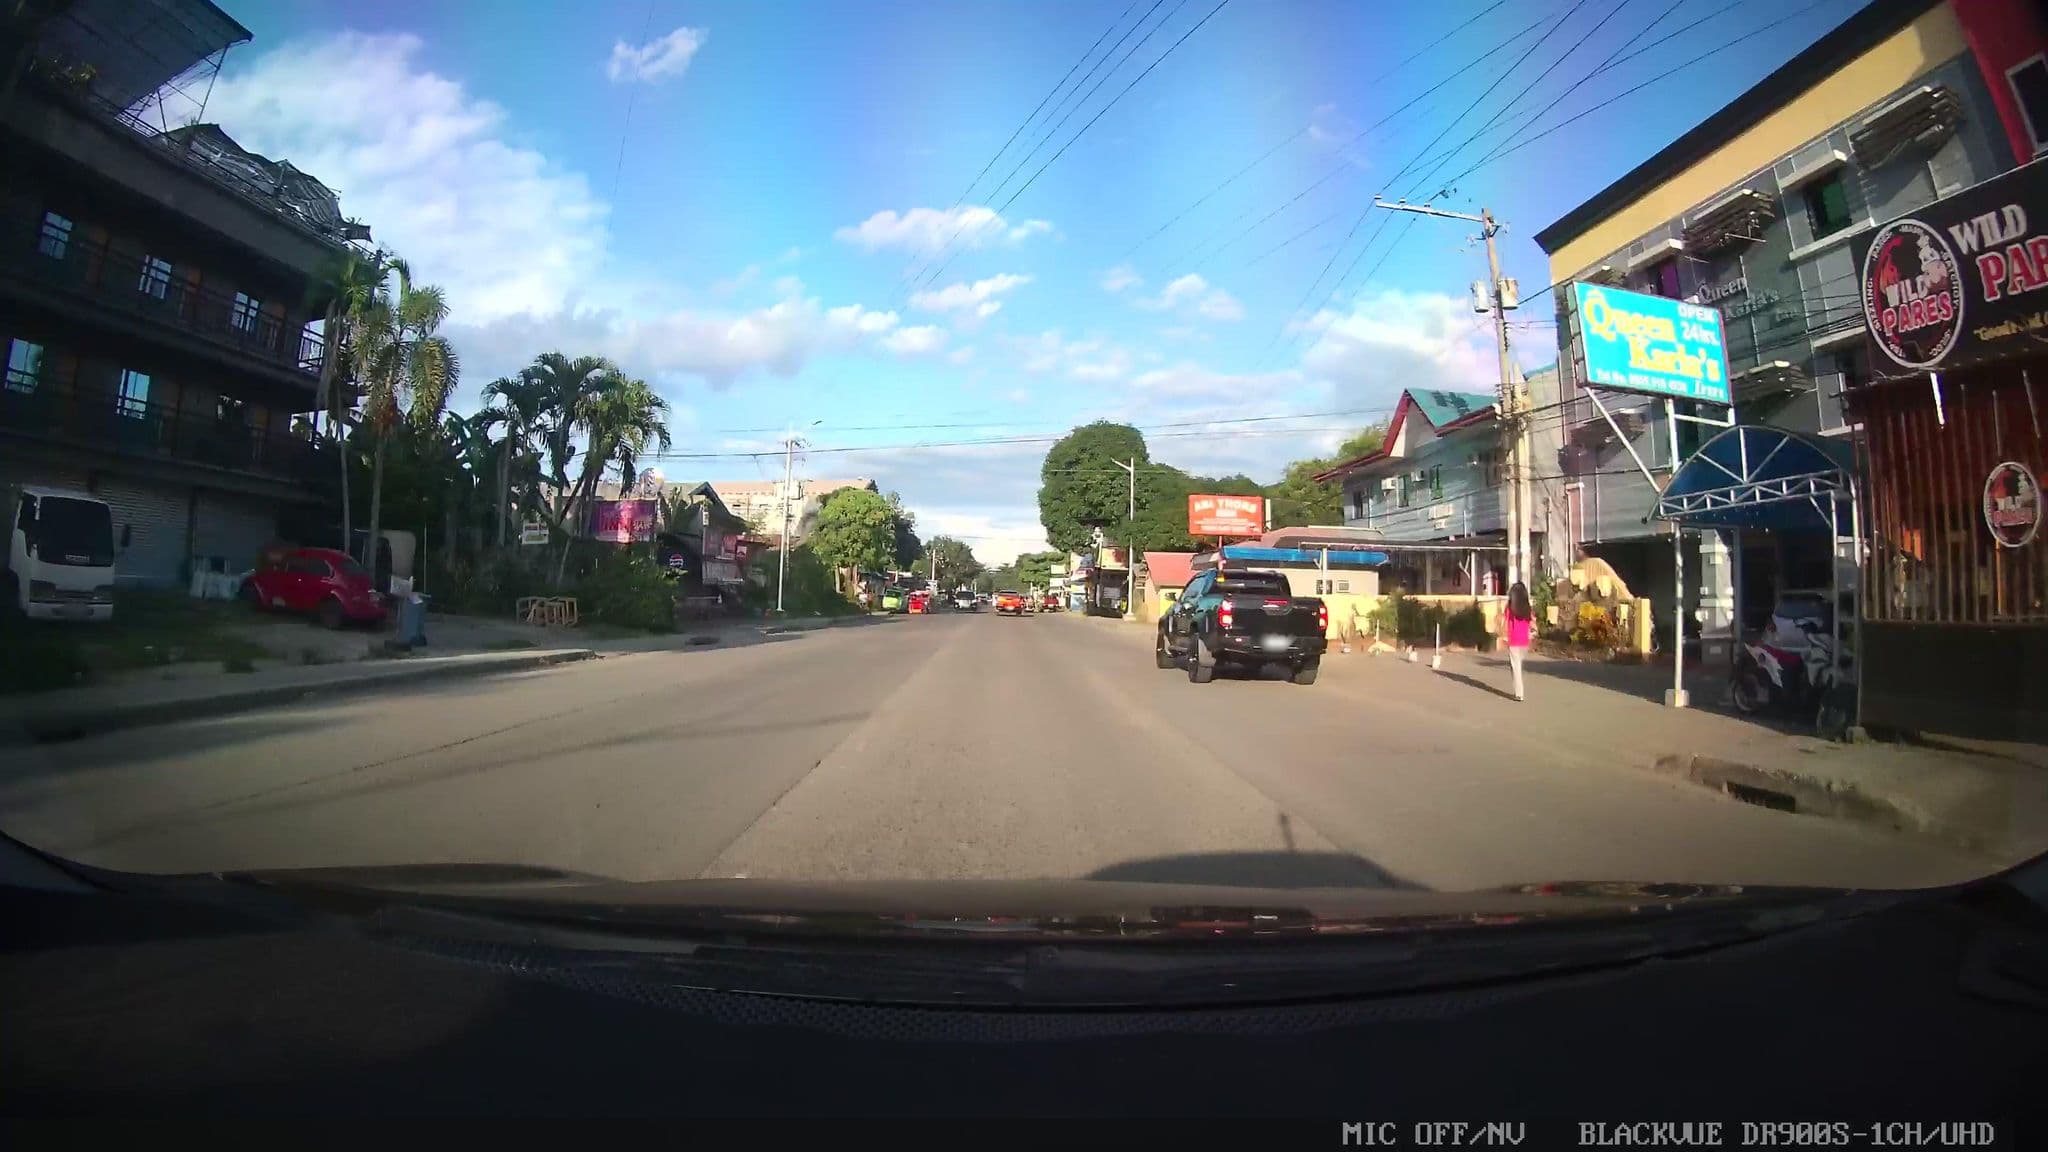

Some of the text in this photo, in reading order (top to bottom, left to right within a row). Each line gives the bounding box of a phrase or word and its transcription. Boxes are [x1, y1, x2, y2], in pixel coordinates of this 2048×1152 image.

[1948, 204, 2027, 255] WILD
[1677, 303, 1716, 322] OPEN
[1698, 277, 1747, 304] Queen
[1584, 293, 1676, 342] Queen
[1883, 291, 1954, 336] PARES
